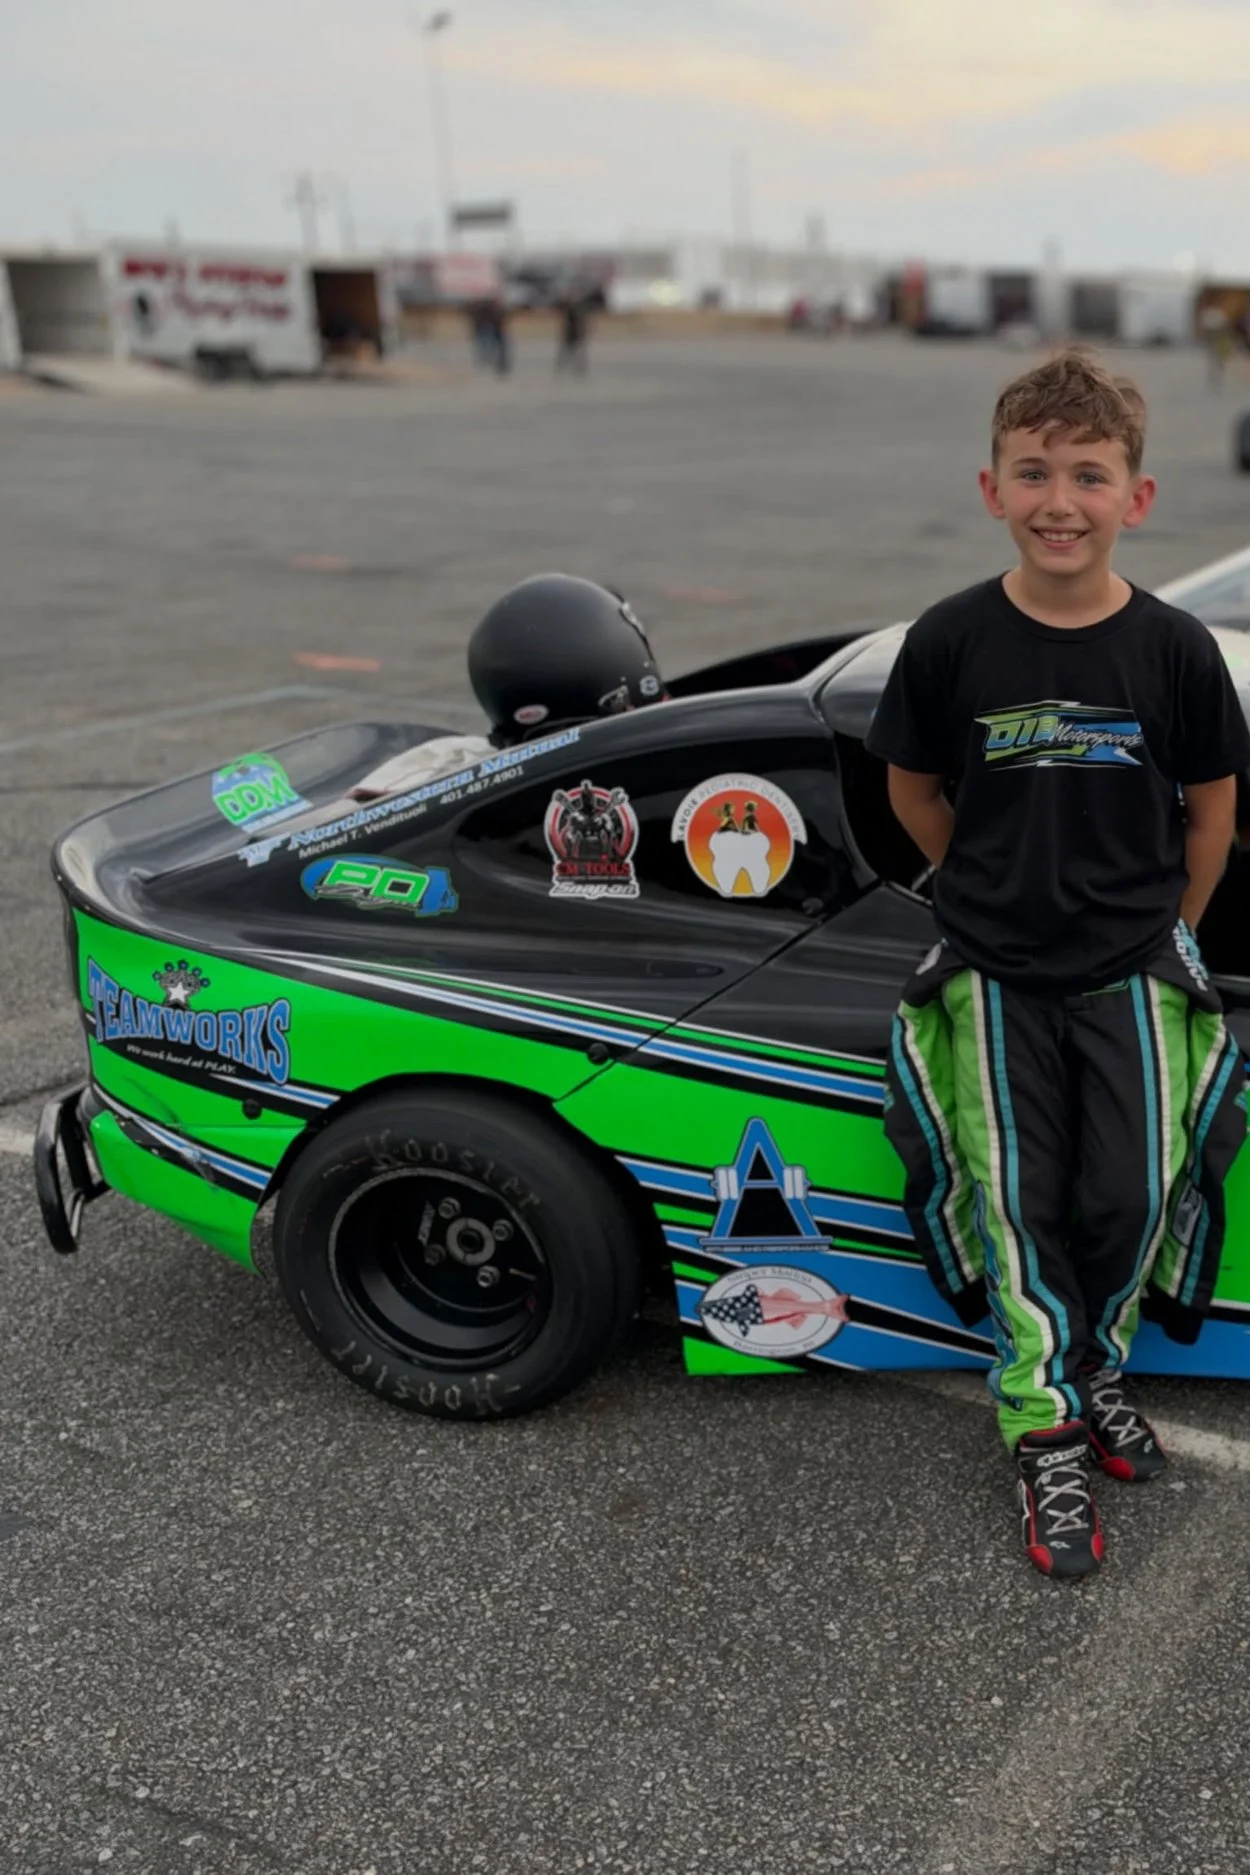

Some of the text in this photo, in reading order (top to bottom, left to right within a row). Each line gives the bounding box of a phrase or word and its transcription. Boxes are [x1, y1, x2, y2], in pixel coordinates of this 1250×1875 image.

[213, 774, 299, 826] DDM
[287, 771, 475, 851] Northwestern
[299, 832, 350, 858] Michael
[351, 829, 365, 842] T.
[365, 803, 428, 837] Vendituoli
[556, 881, 635, 898] Snap-on
[584, 861, 631, 876] TOOLS
[88, 957, 291, 1085] TEAMWORKS
[126, 1043, 142, 1054] We
[142, 1048, 165, 1063] work
[166, 1051, 191, 1067] hard
[191, 1057, 204, 1068] at
